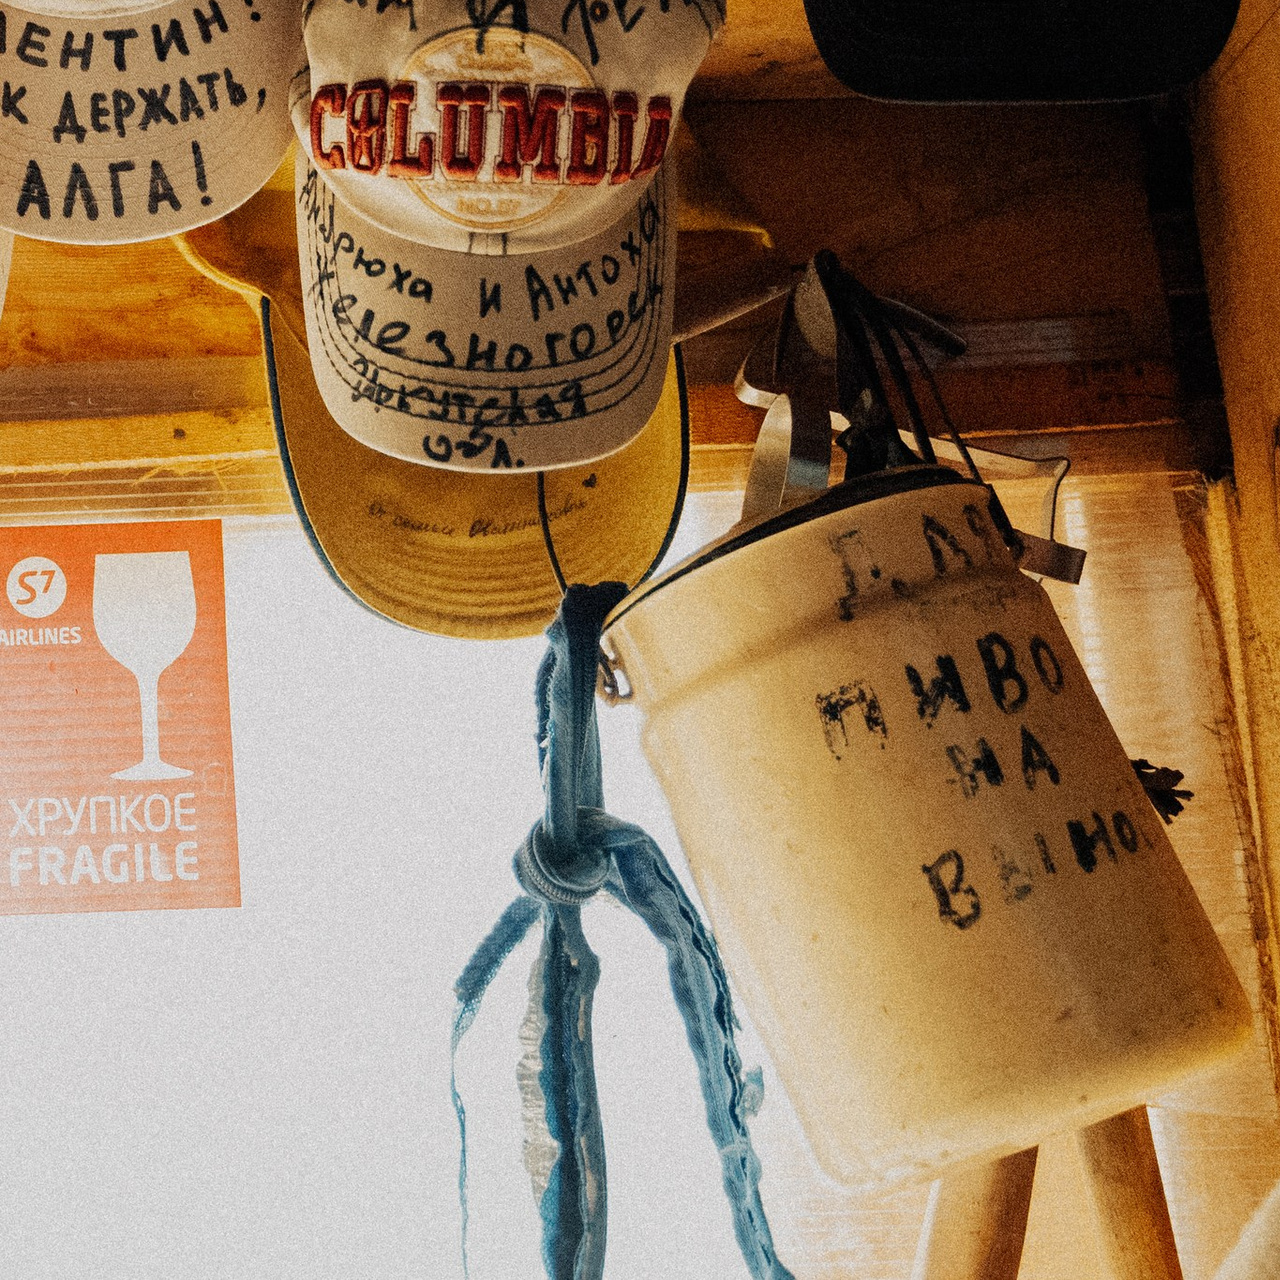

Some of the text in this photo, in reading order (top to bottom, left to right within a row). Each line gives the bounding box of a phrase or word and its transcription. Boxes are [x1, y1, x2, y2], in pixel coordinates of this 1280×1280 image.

[52, 66, 267, 143] ДЕРЖАТЬ,
[16, 140, 214, 221] АЛГА!
[16, 569, 56, 606] S7
[7, 791, 197, 838] ХРУПКОЕ
[9, 840, 200, 888] FRAGILE
